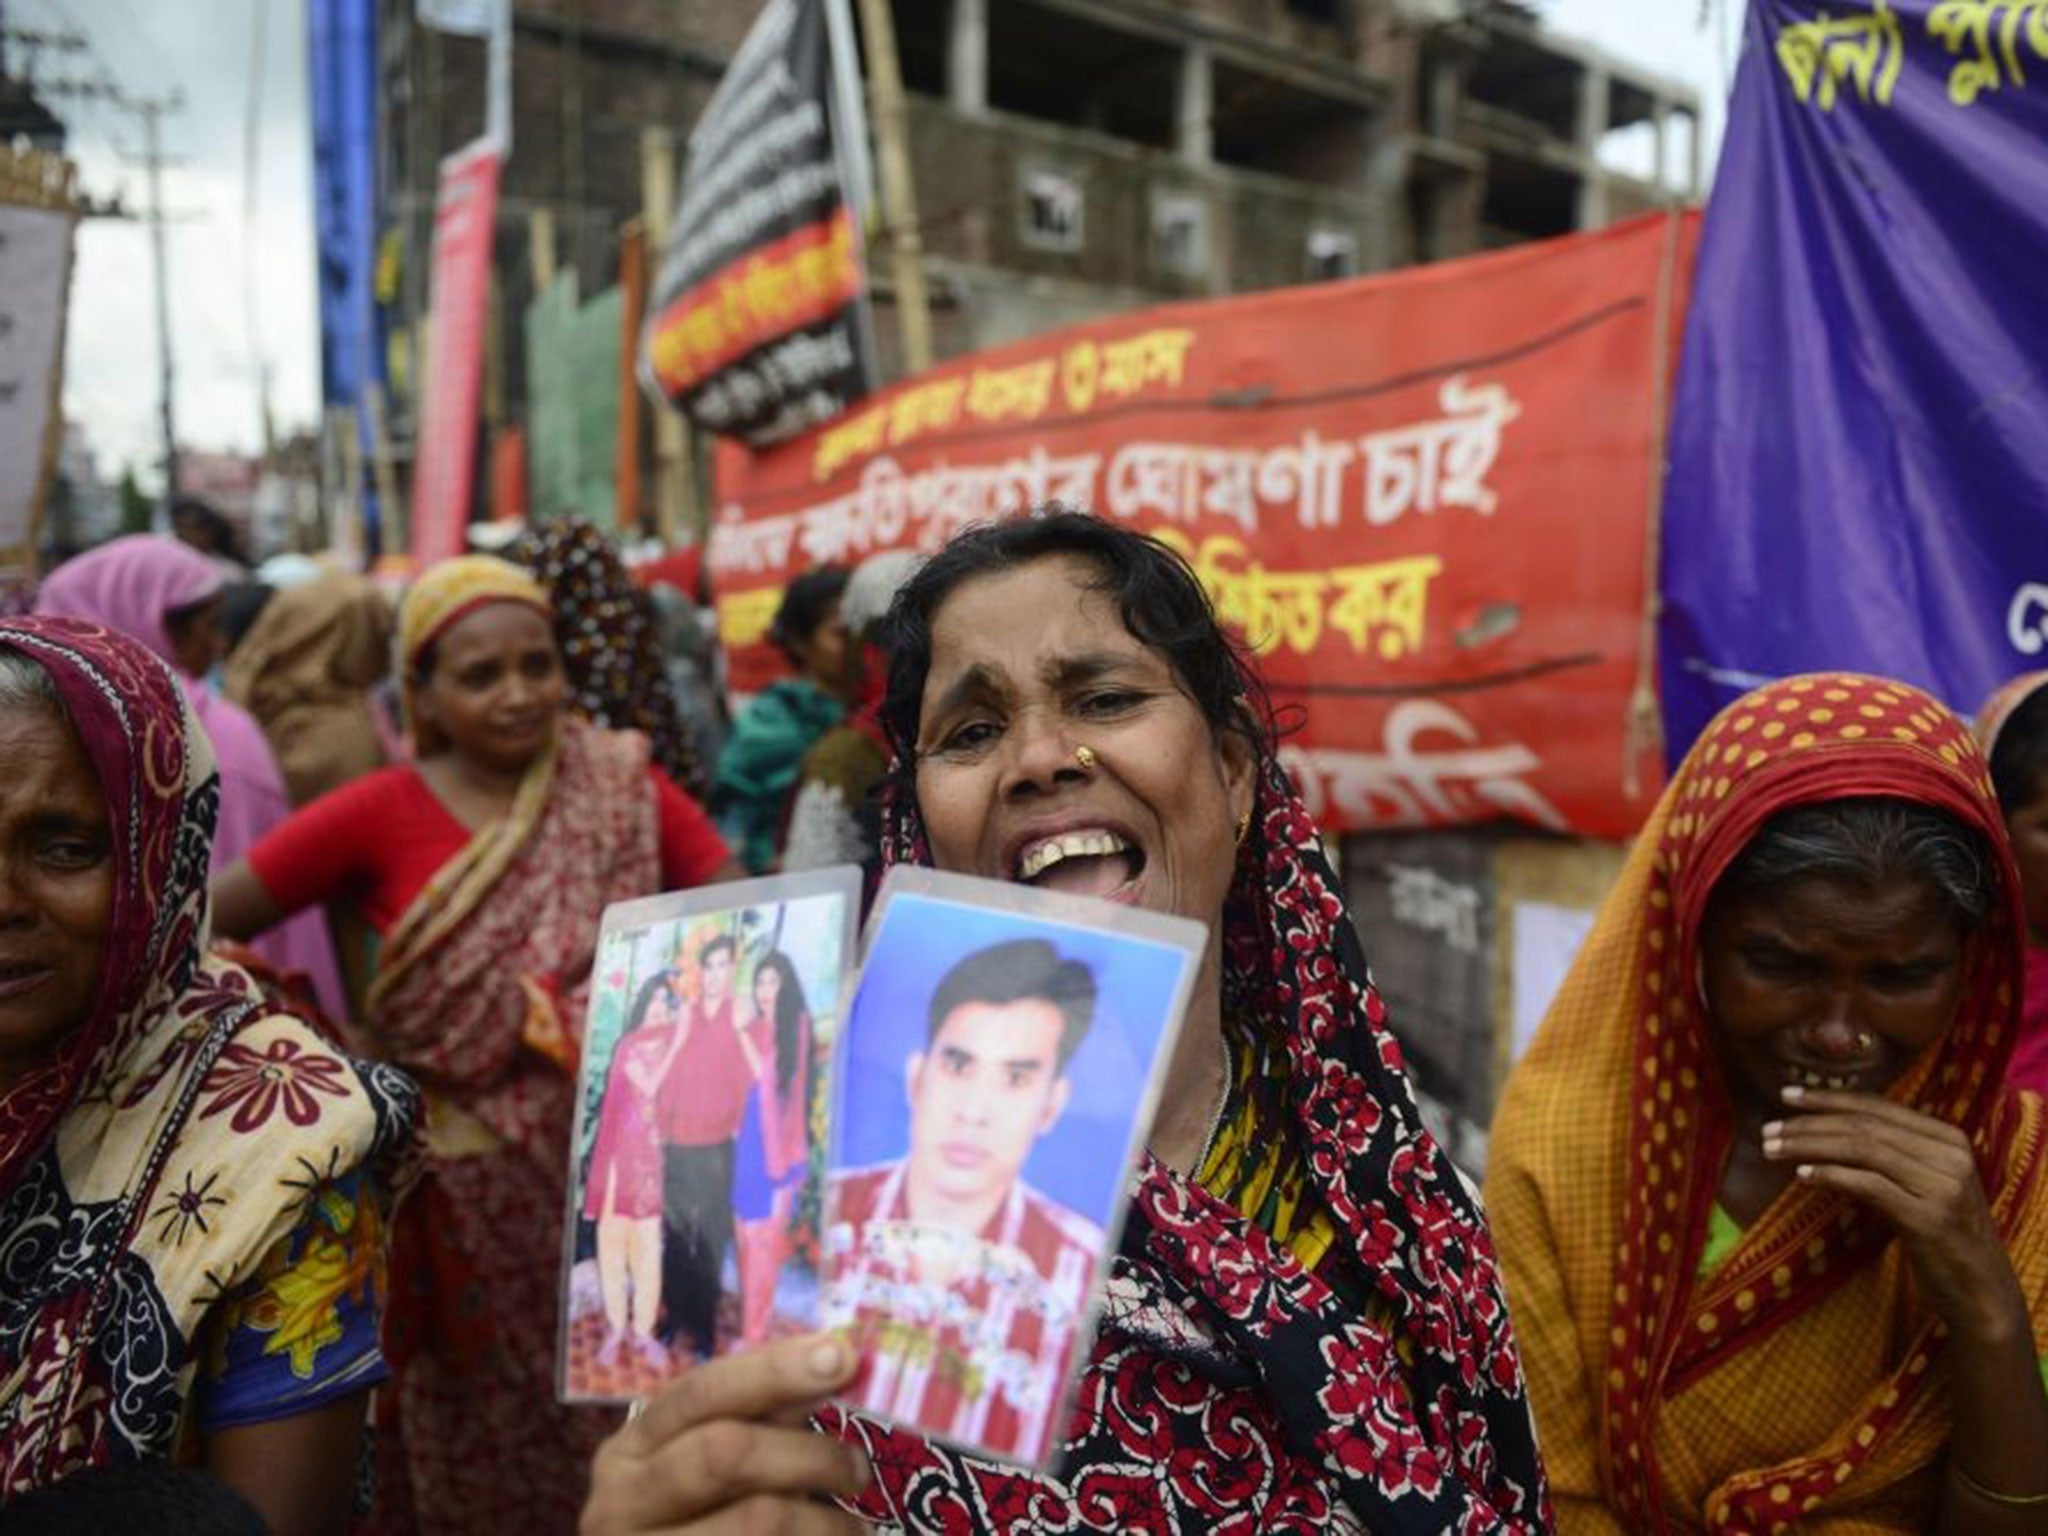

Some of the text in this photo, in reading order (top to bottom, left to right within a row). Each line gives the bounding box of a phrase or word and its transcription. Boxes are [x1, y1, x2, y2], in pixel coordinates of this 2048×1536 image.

[1106, 428, 1356, 534] ঘোষণা
[1357, 373, 1521, 525] চাই
[1328, 554, 1443, 661] কর
